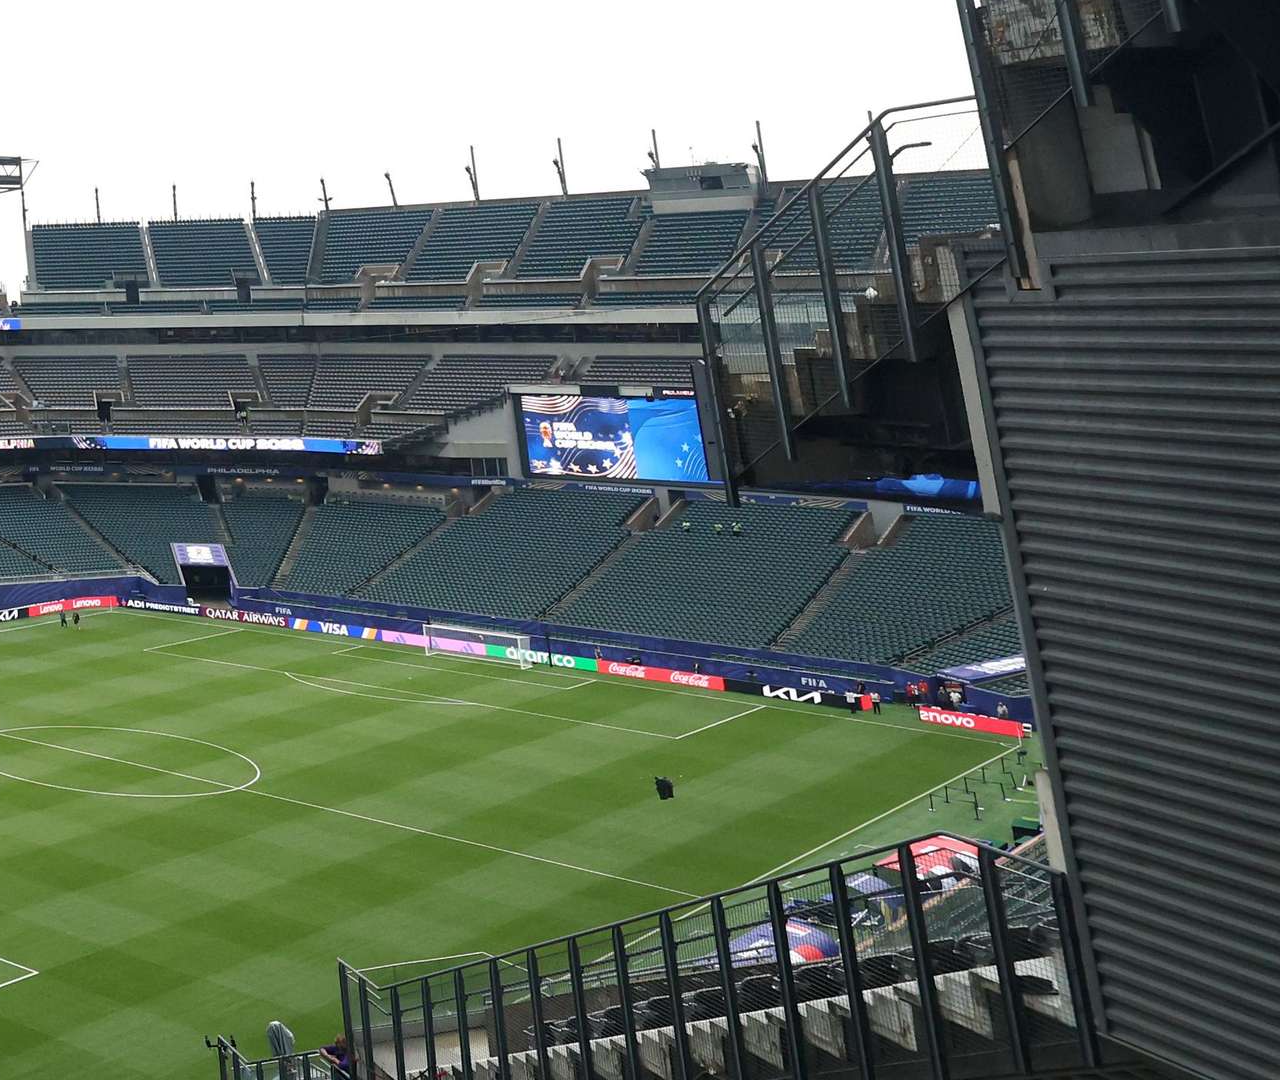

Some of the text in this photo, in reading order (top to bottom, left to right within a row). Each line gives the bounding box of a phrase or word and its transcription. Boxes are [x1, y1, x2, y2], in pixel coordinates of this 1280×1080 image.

[148, 437, 179, 449] FIFA
[179, 437, 227, 450] WORLD
[227, 438, 256, 450] CUP
[207, 467, 280, 475] PHILADELPHIA
[584, 484, 598, 492] FIFA
[906, 505, 922, 513] FIFA
[72, 597, 101, 608] Lenovo
[127, 599, 199, 615] ADI PREDICTSTREET
[40, 603, 63, 614] Lenovo
[275, 606, 292, 616] FIFA
[206, 608, 286, 627] QATAR AIRWAYS
[319, 621, 349, 636] VISA
[505, 647, 576, 668] aramco
